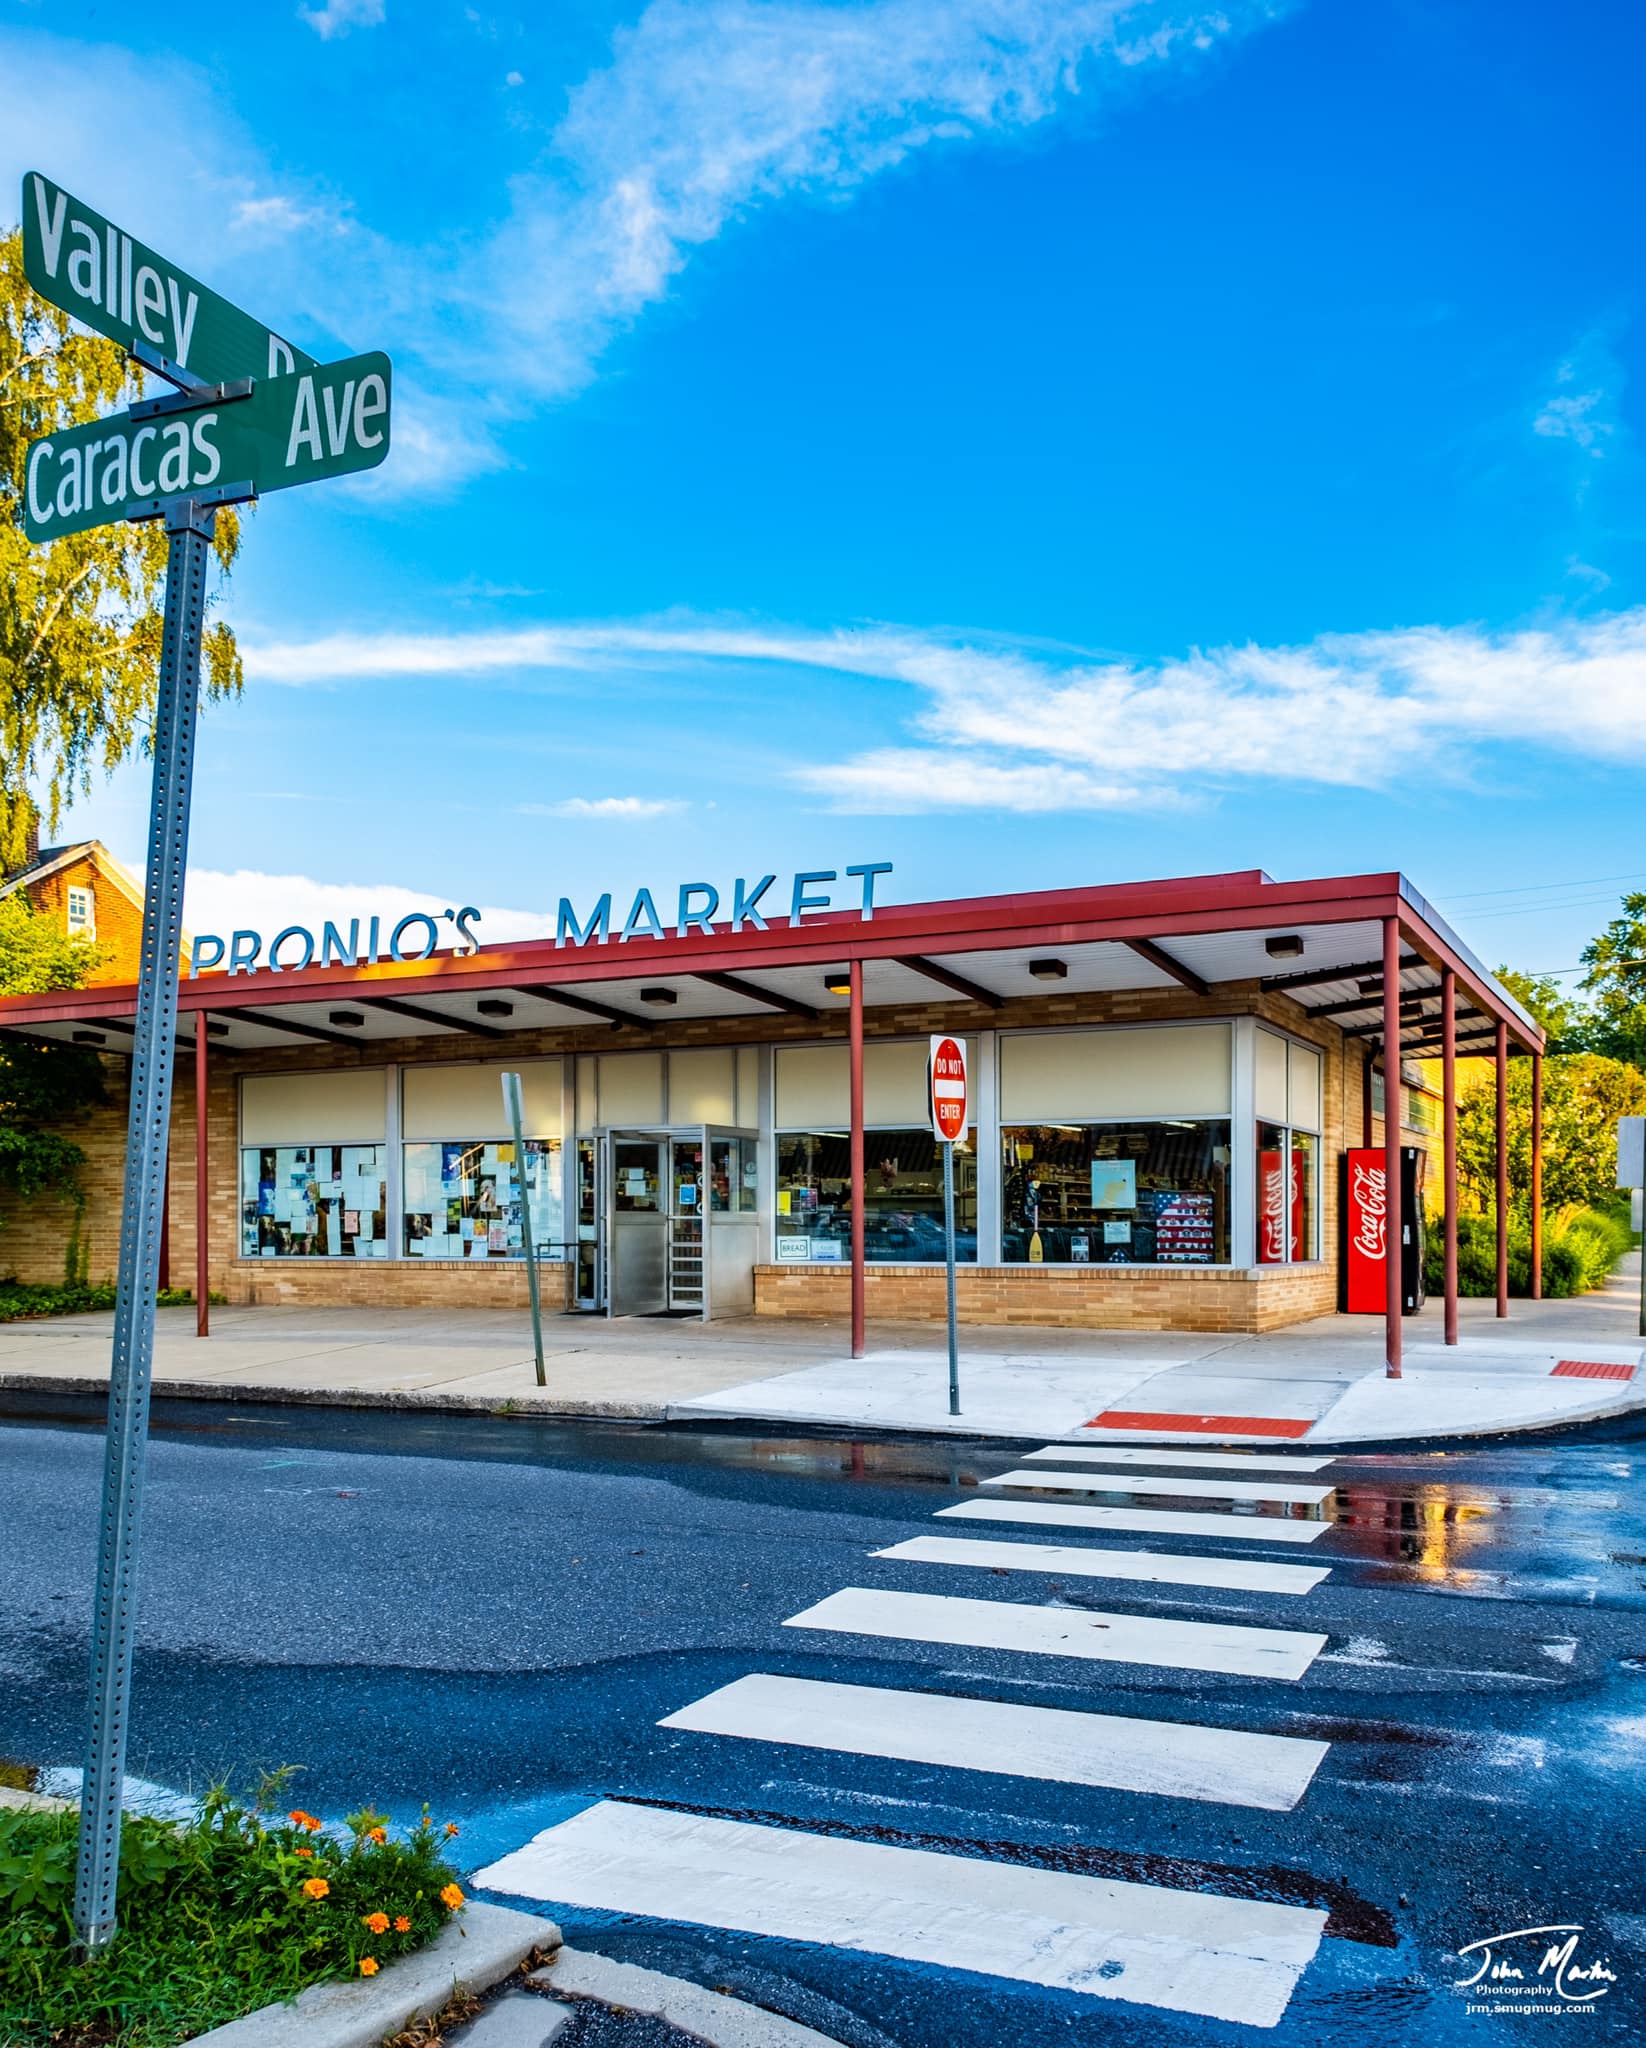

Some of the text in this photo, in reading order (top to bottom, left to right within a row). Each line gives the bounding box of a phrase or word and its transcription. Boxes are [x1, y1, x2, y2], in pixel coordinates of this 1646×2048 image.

[32, 173, 199, 369] Valley
[27, 373, 388, 525] Caracas Ave
[189, 862, 894, 980] PRONIO'S MARKET
[937, 1058, 962, 1075] DO NOT
[940, 1103, 961, 1119] ENTER
